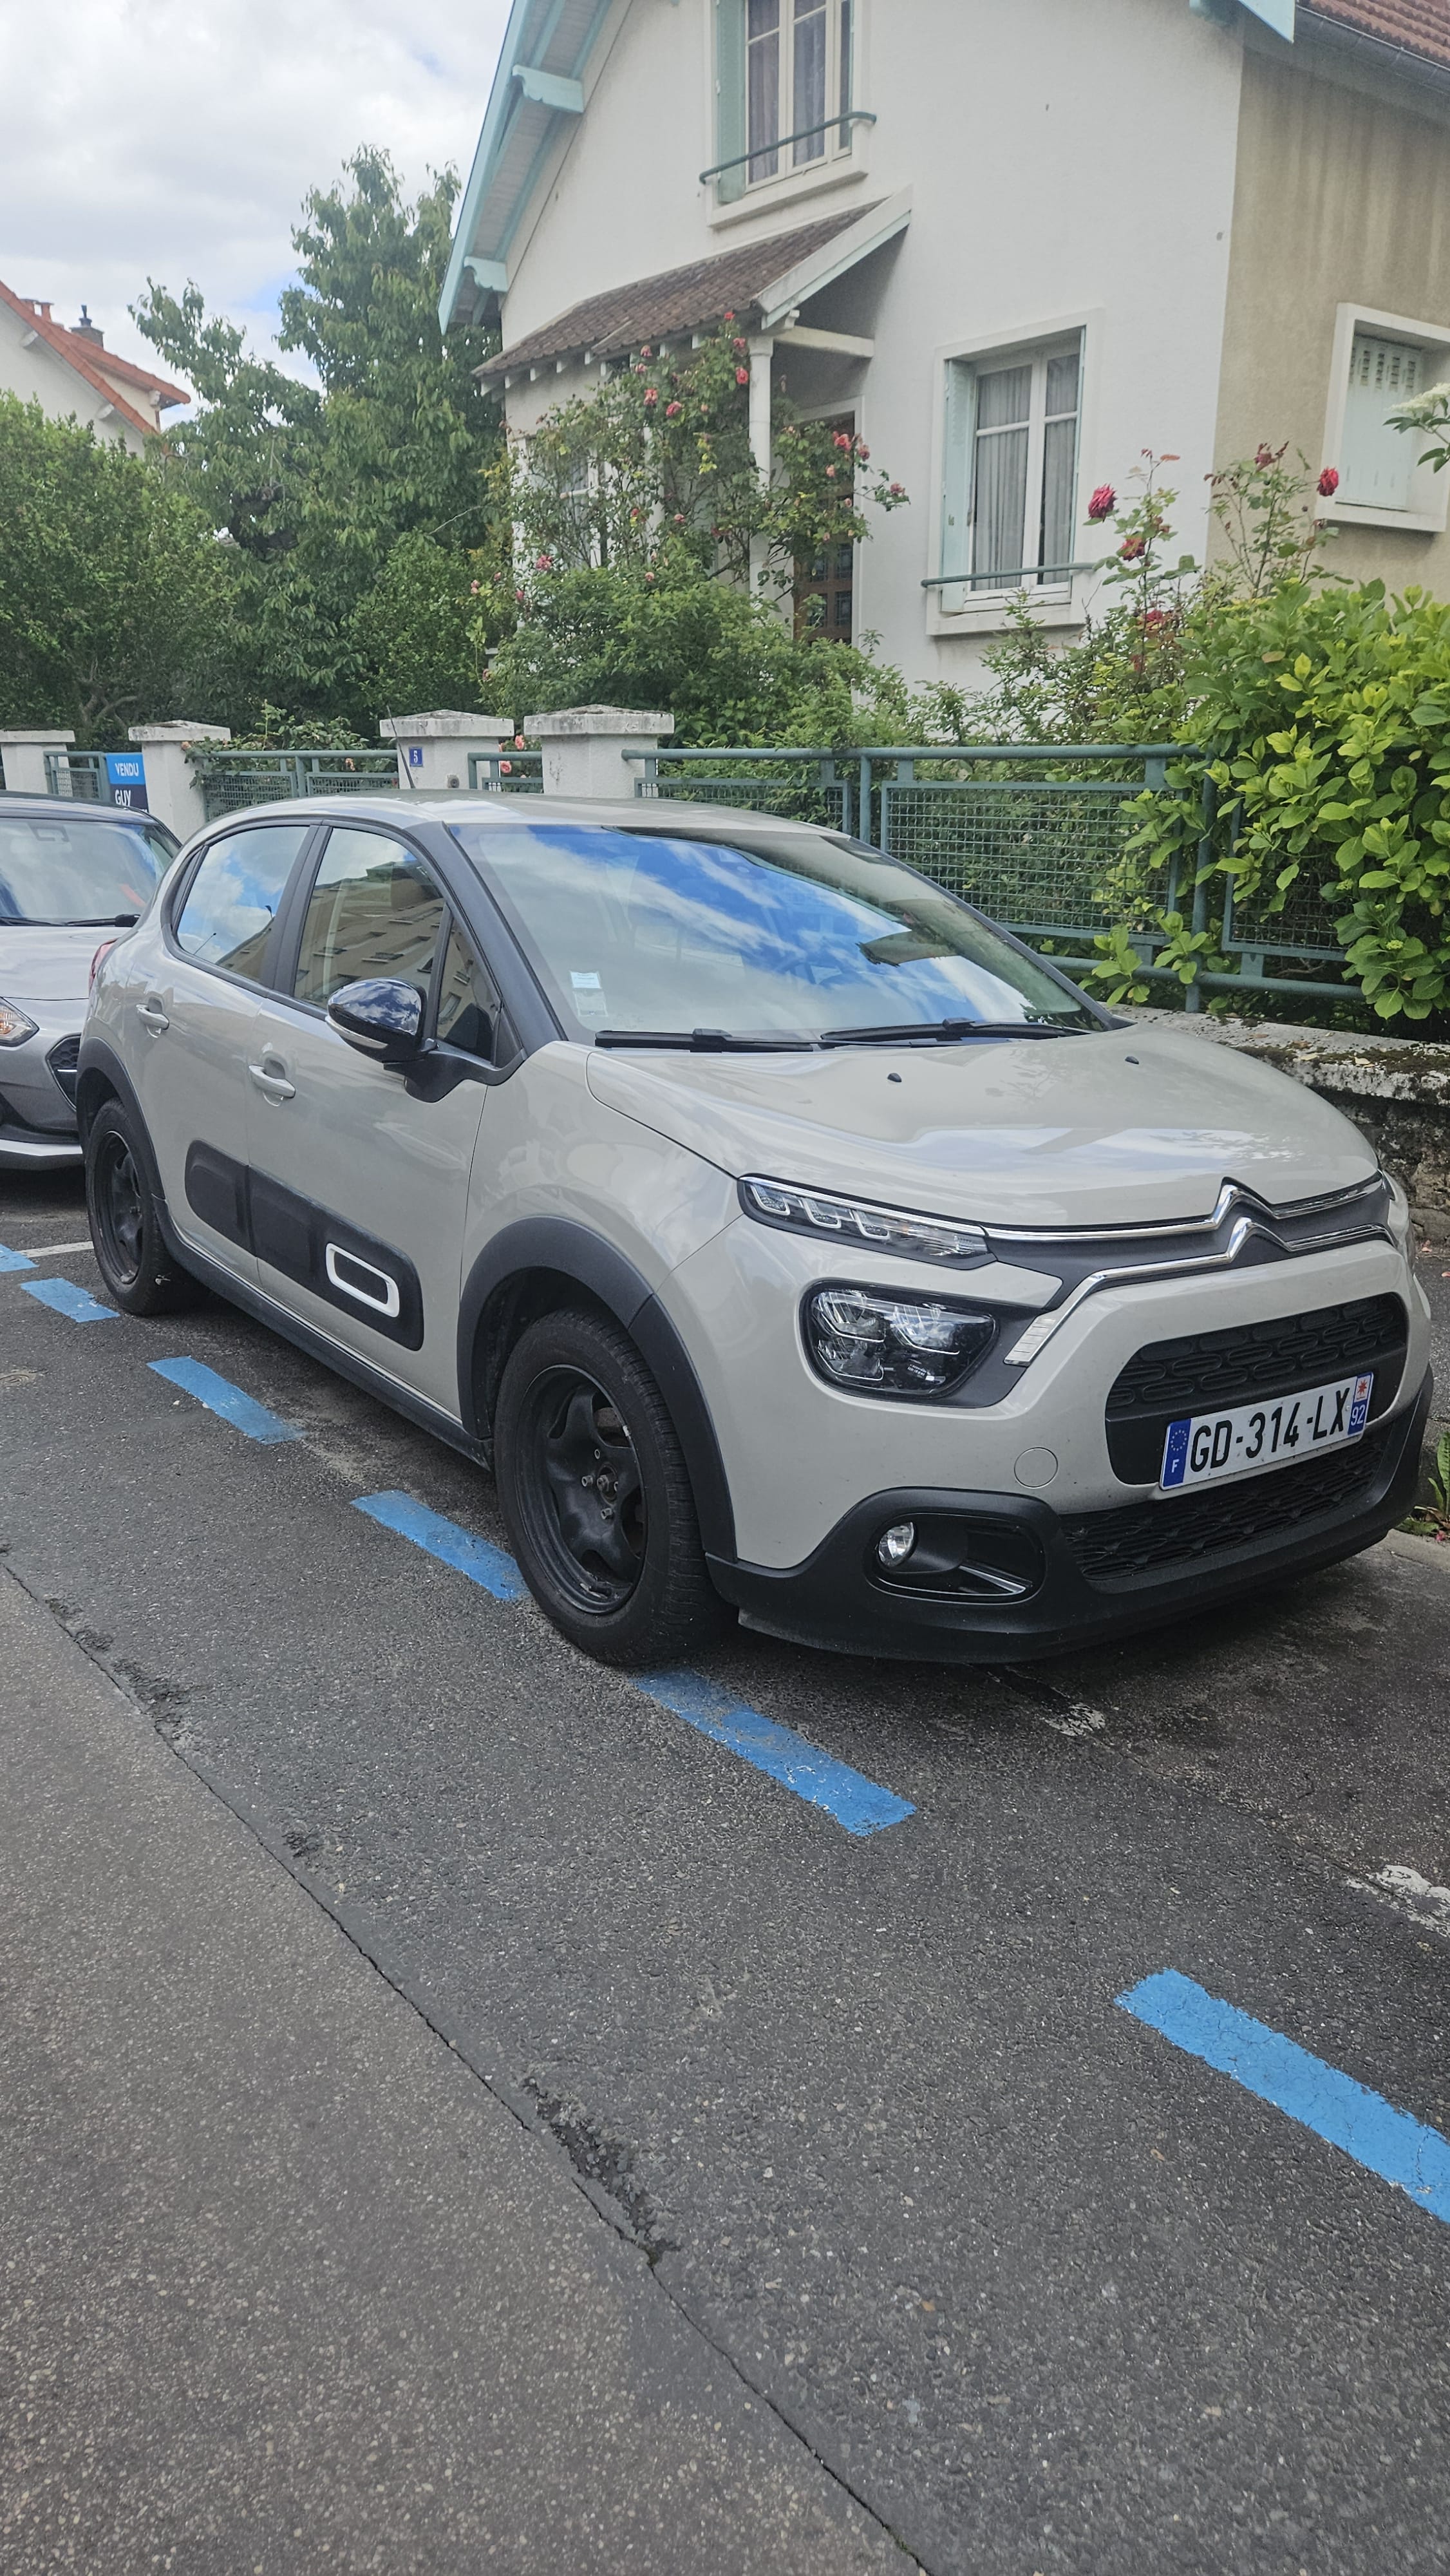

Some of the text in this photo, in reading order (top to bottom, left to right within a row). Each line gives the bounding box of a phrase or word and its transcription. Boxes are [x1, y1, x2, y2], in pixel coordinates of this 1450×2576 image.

[413, 750, 418, 763] 5
[115, 762, 139, 777] VENDU
[115, 790, 131, 806] GUY
[1351, 1405, 1366, 1426] 92
[1190, 1388, 1350, 1472] GD-314-LX
[1171, 1459, 1180, 1473] F
